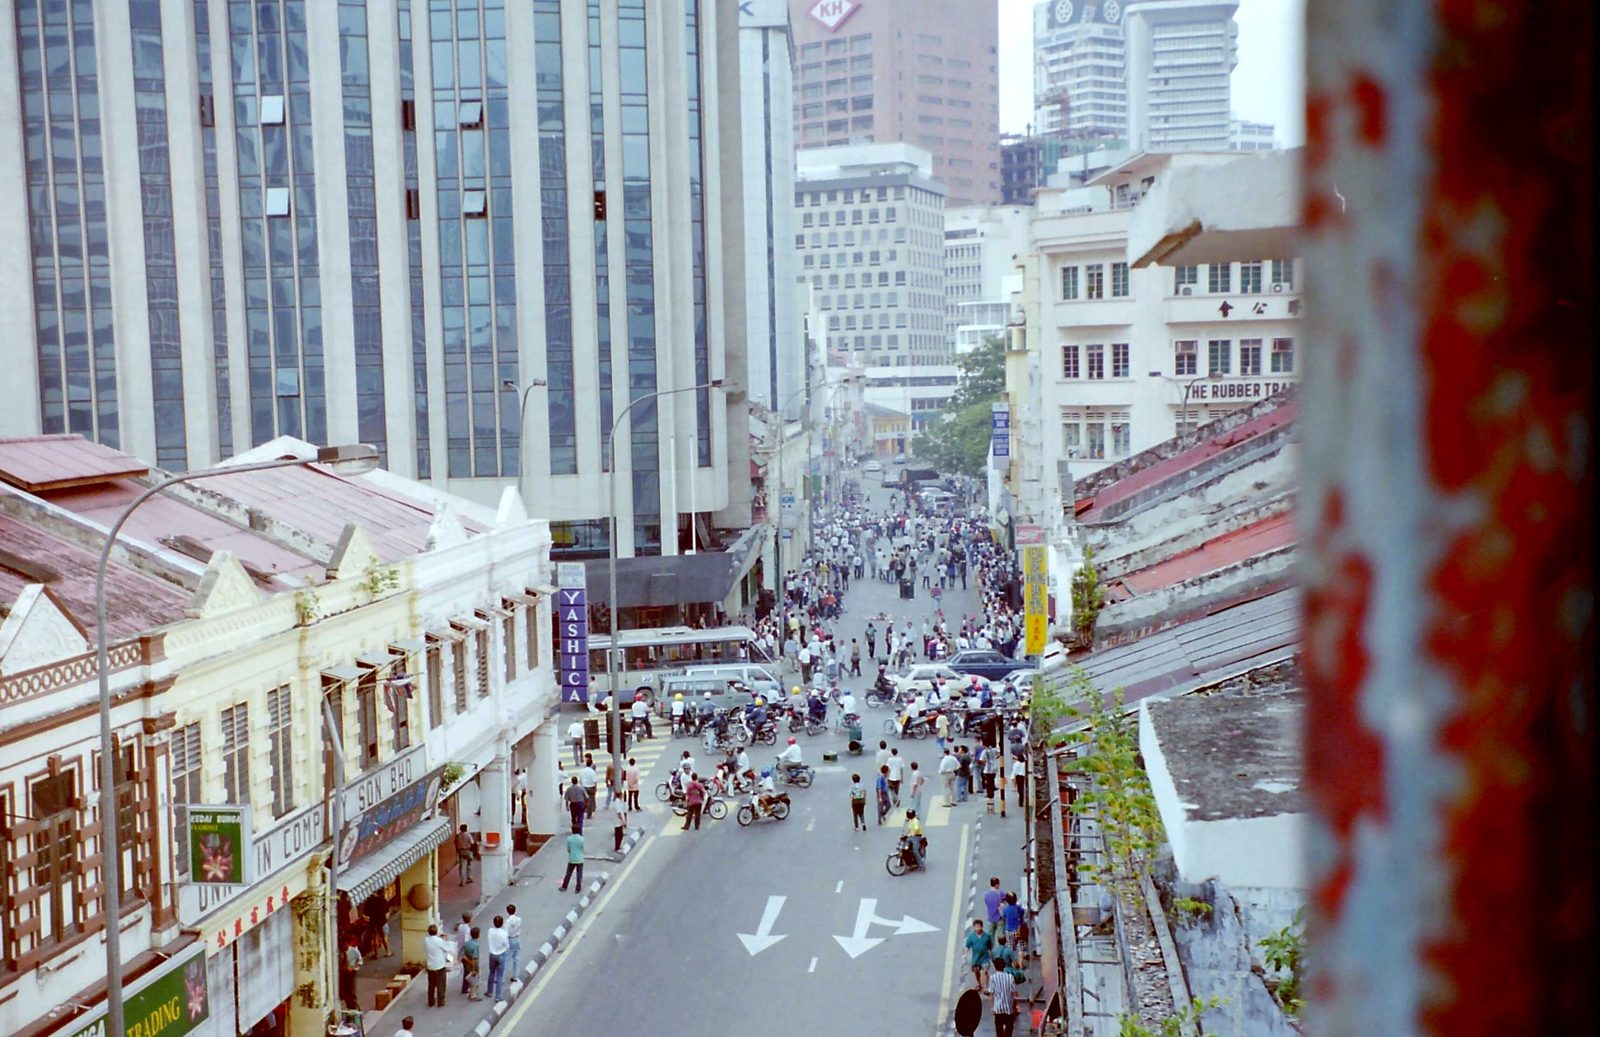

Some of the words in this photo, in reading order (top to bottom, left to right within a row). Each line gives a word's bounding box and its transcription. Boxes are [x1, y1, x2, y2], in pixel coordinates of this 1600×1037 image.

[820, 1, 843, 17] KH
[1184, 384, 1208, 399] THE
[1212, 383, 1261, 398] RUBBER
[563, 591, 581, 702] YASHICA
